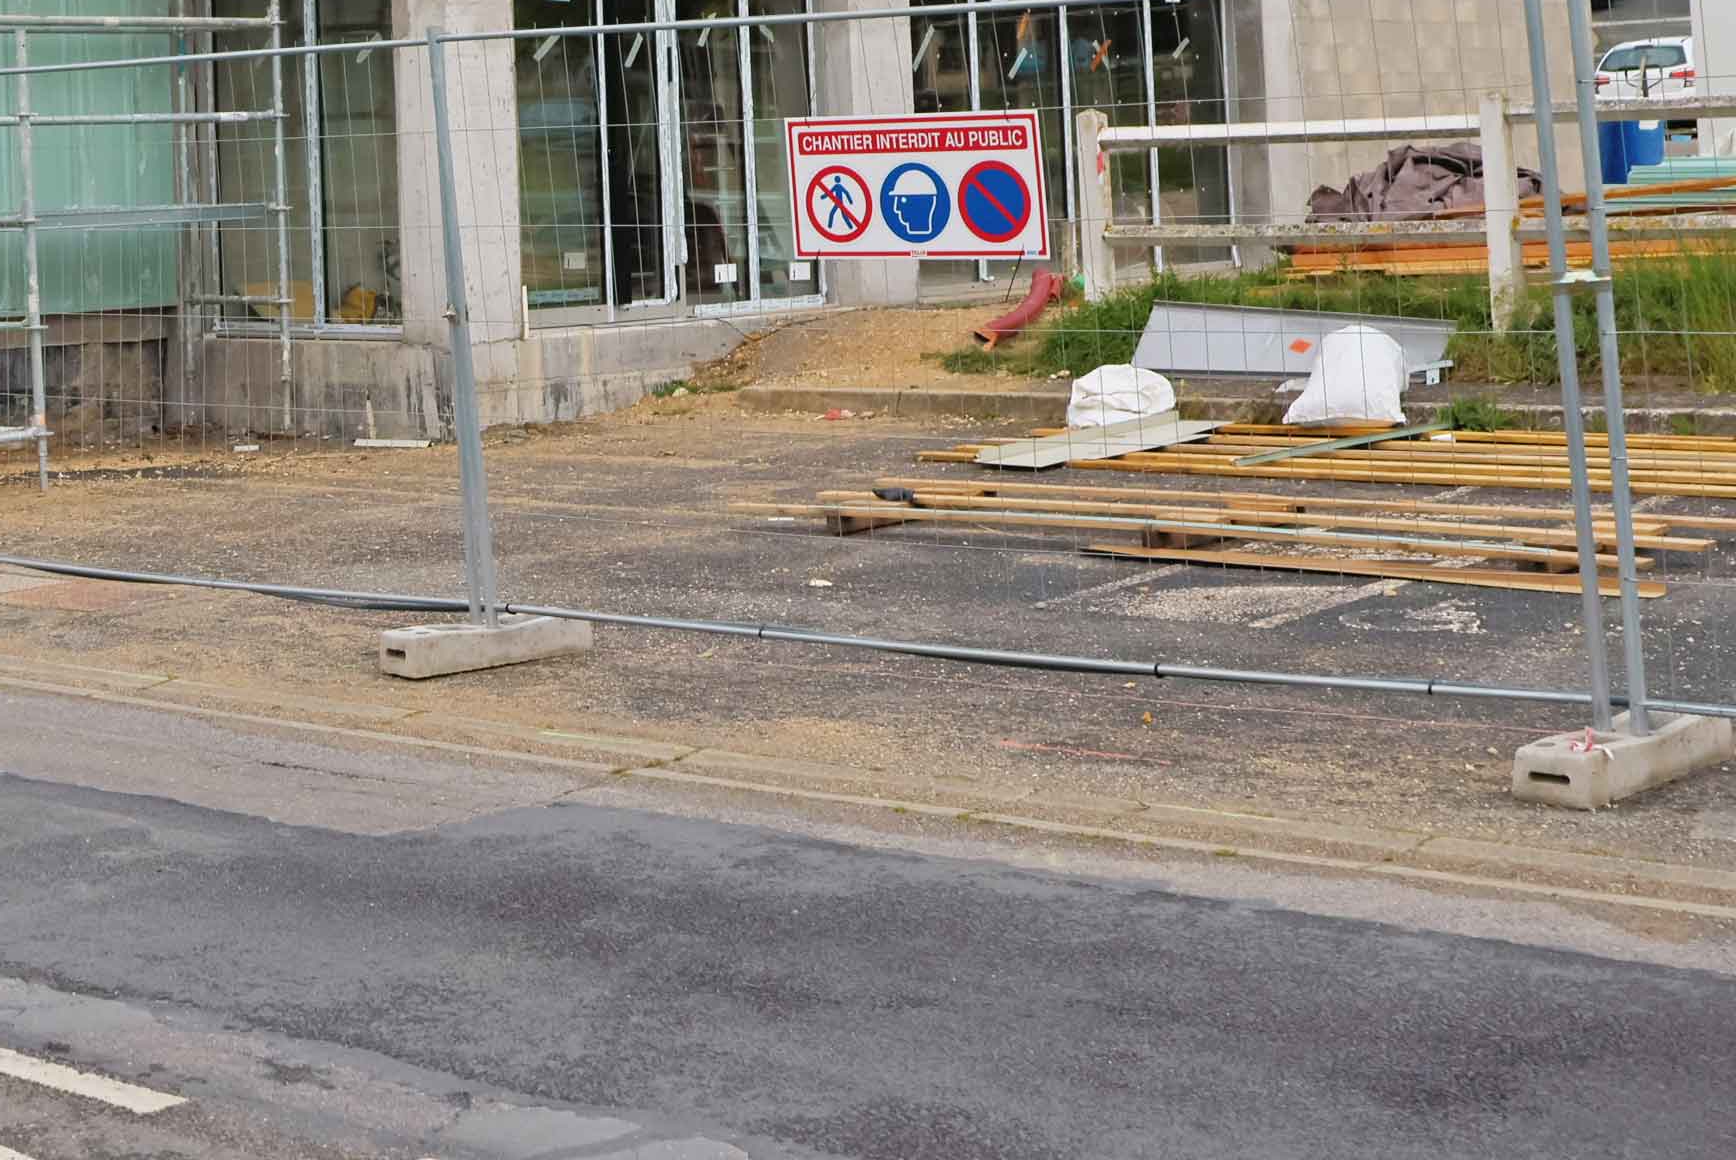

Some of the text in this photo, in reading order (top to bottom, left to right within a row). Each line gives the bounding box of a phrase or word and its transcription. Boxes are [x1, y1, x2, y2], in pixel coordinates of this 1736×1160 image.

[802, 129, 1023, 152] CHANTIER INTERDIT AU PUBLIC
